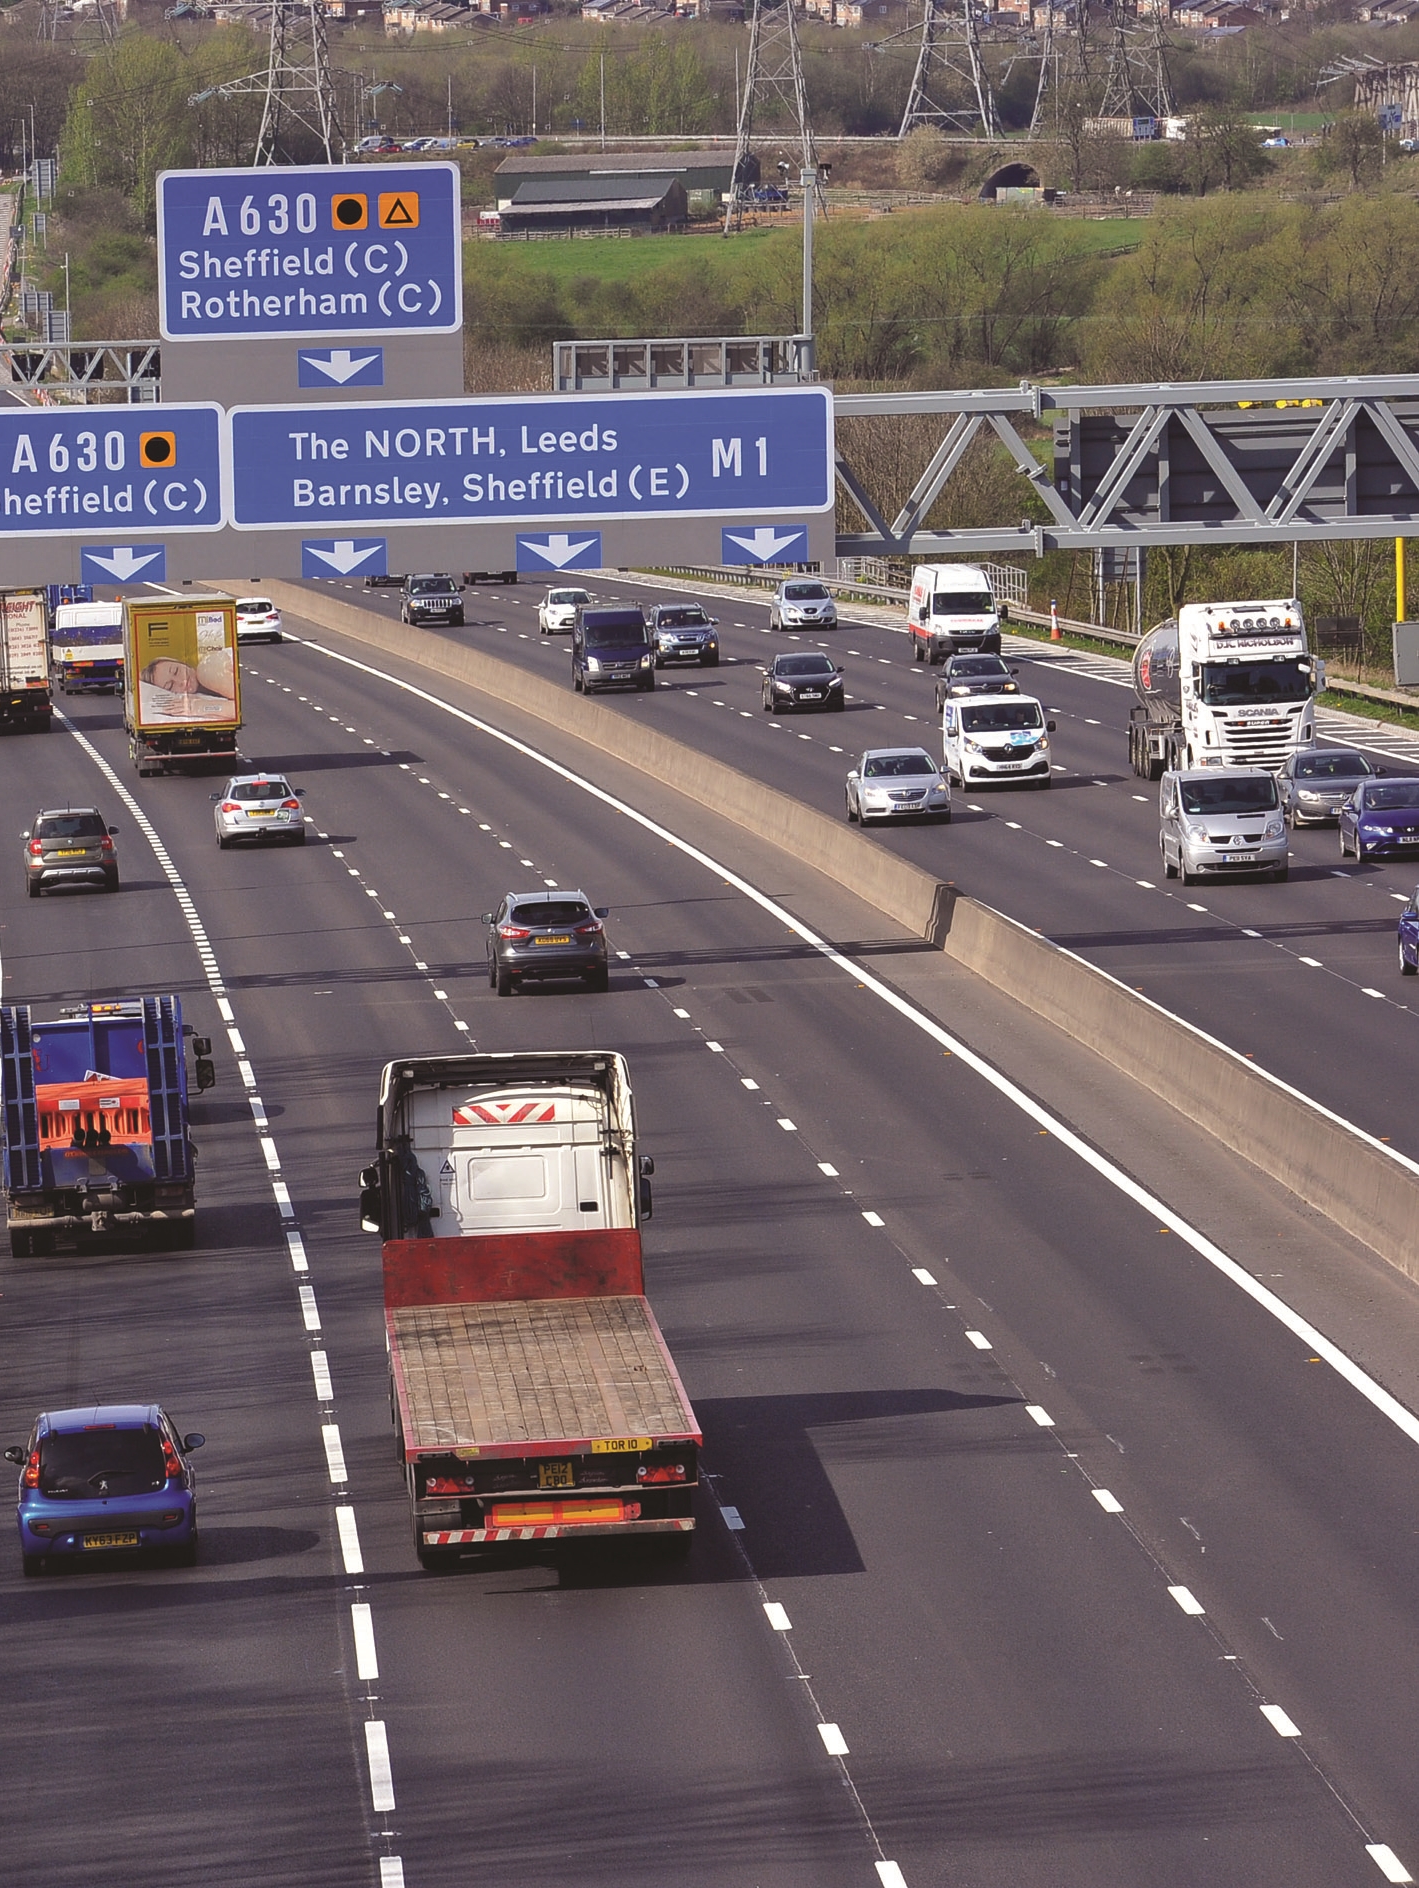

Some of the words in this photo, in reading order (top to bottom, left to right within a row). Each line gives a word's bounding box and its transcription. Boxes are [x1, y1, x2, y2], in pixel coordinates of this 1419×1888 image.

[180, 247, 333, 278] Sheffield
[345, 241, 407, 277] (C)
[182, 288, 366, 318] Rotherham
[379, 280, 441, 316] (C)
[289, 433, 348, 459] The
[366, 427, 505, 457] NORTH,
[522, 424, 617, 453] Leeds
[144, 479, 206, 515] (C)
[294, 477, 448, 508] Barnsley,
[463, 470, 617, 501] Sheffield
[629, 464, 689, 500] (E)
[1238, 708, 1280, 717] SCANIA
[604, 1440, 625, 1450] TOR
[85, 1536, 112, 1546] KY63
[115, 1533, 136, 1543] FZP
